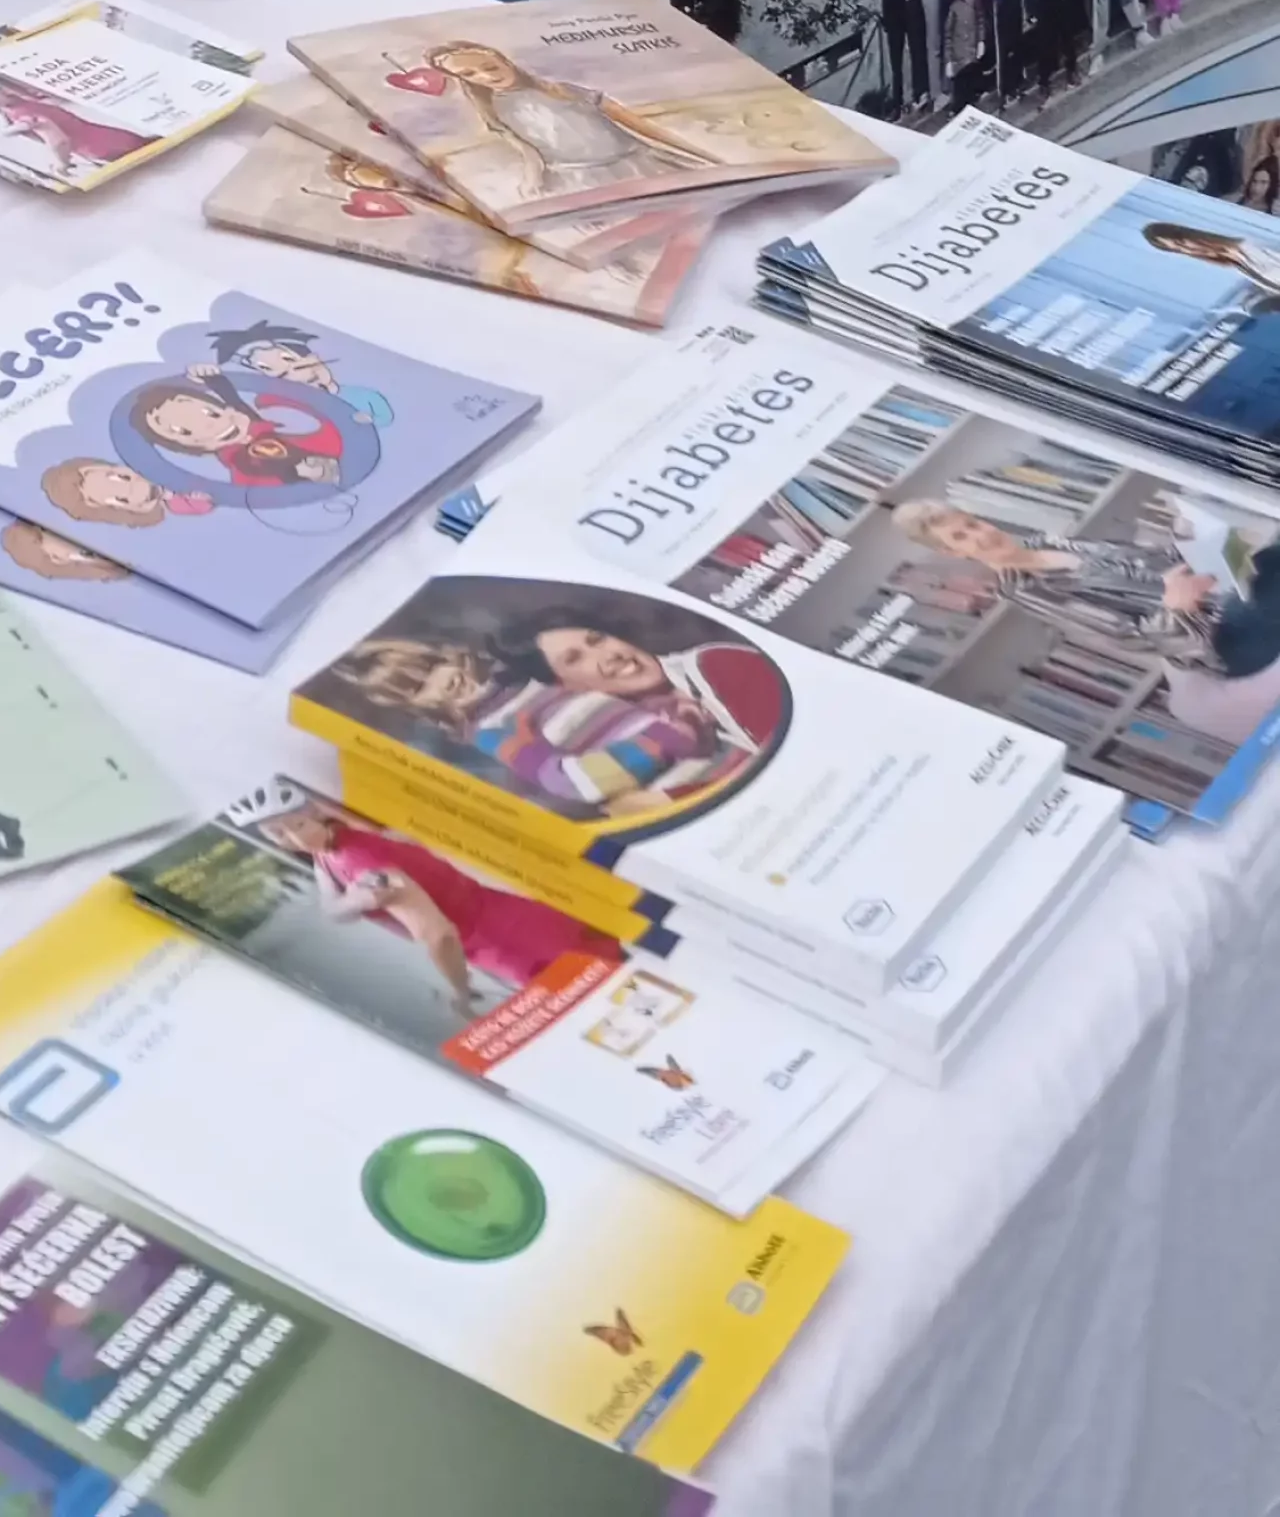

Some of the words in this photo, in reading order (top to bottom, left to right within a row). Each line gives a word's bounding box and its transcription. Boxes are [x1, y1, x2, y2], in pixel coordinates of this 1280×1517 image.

[25, 58, 70, 79] SADA
[45, 56, 108, 87] MOŽETE
[65, 66, 125, 95] MJERITI
[870, 165, 1069, 292] Dijabetes
[577, 369, 814, 546] Dijabetes
[53, 1222, 149, 1309] BOLEST
[77, 1370, 153, 1442] Intervju
[586, 1356, 661, 1436] FreeStyle
